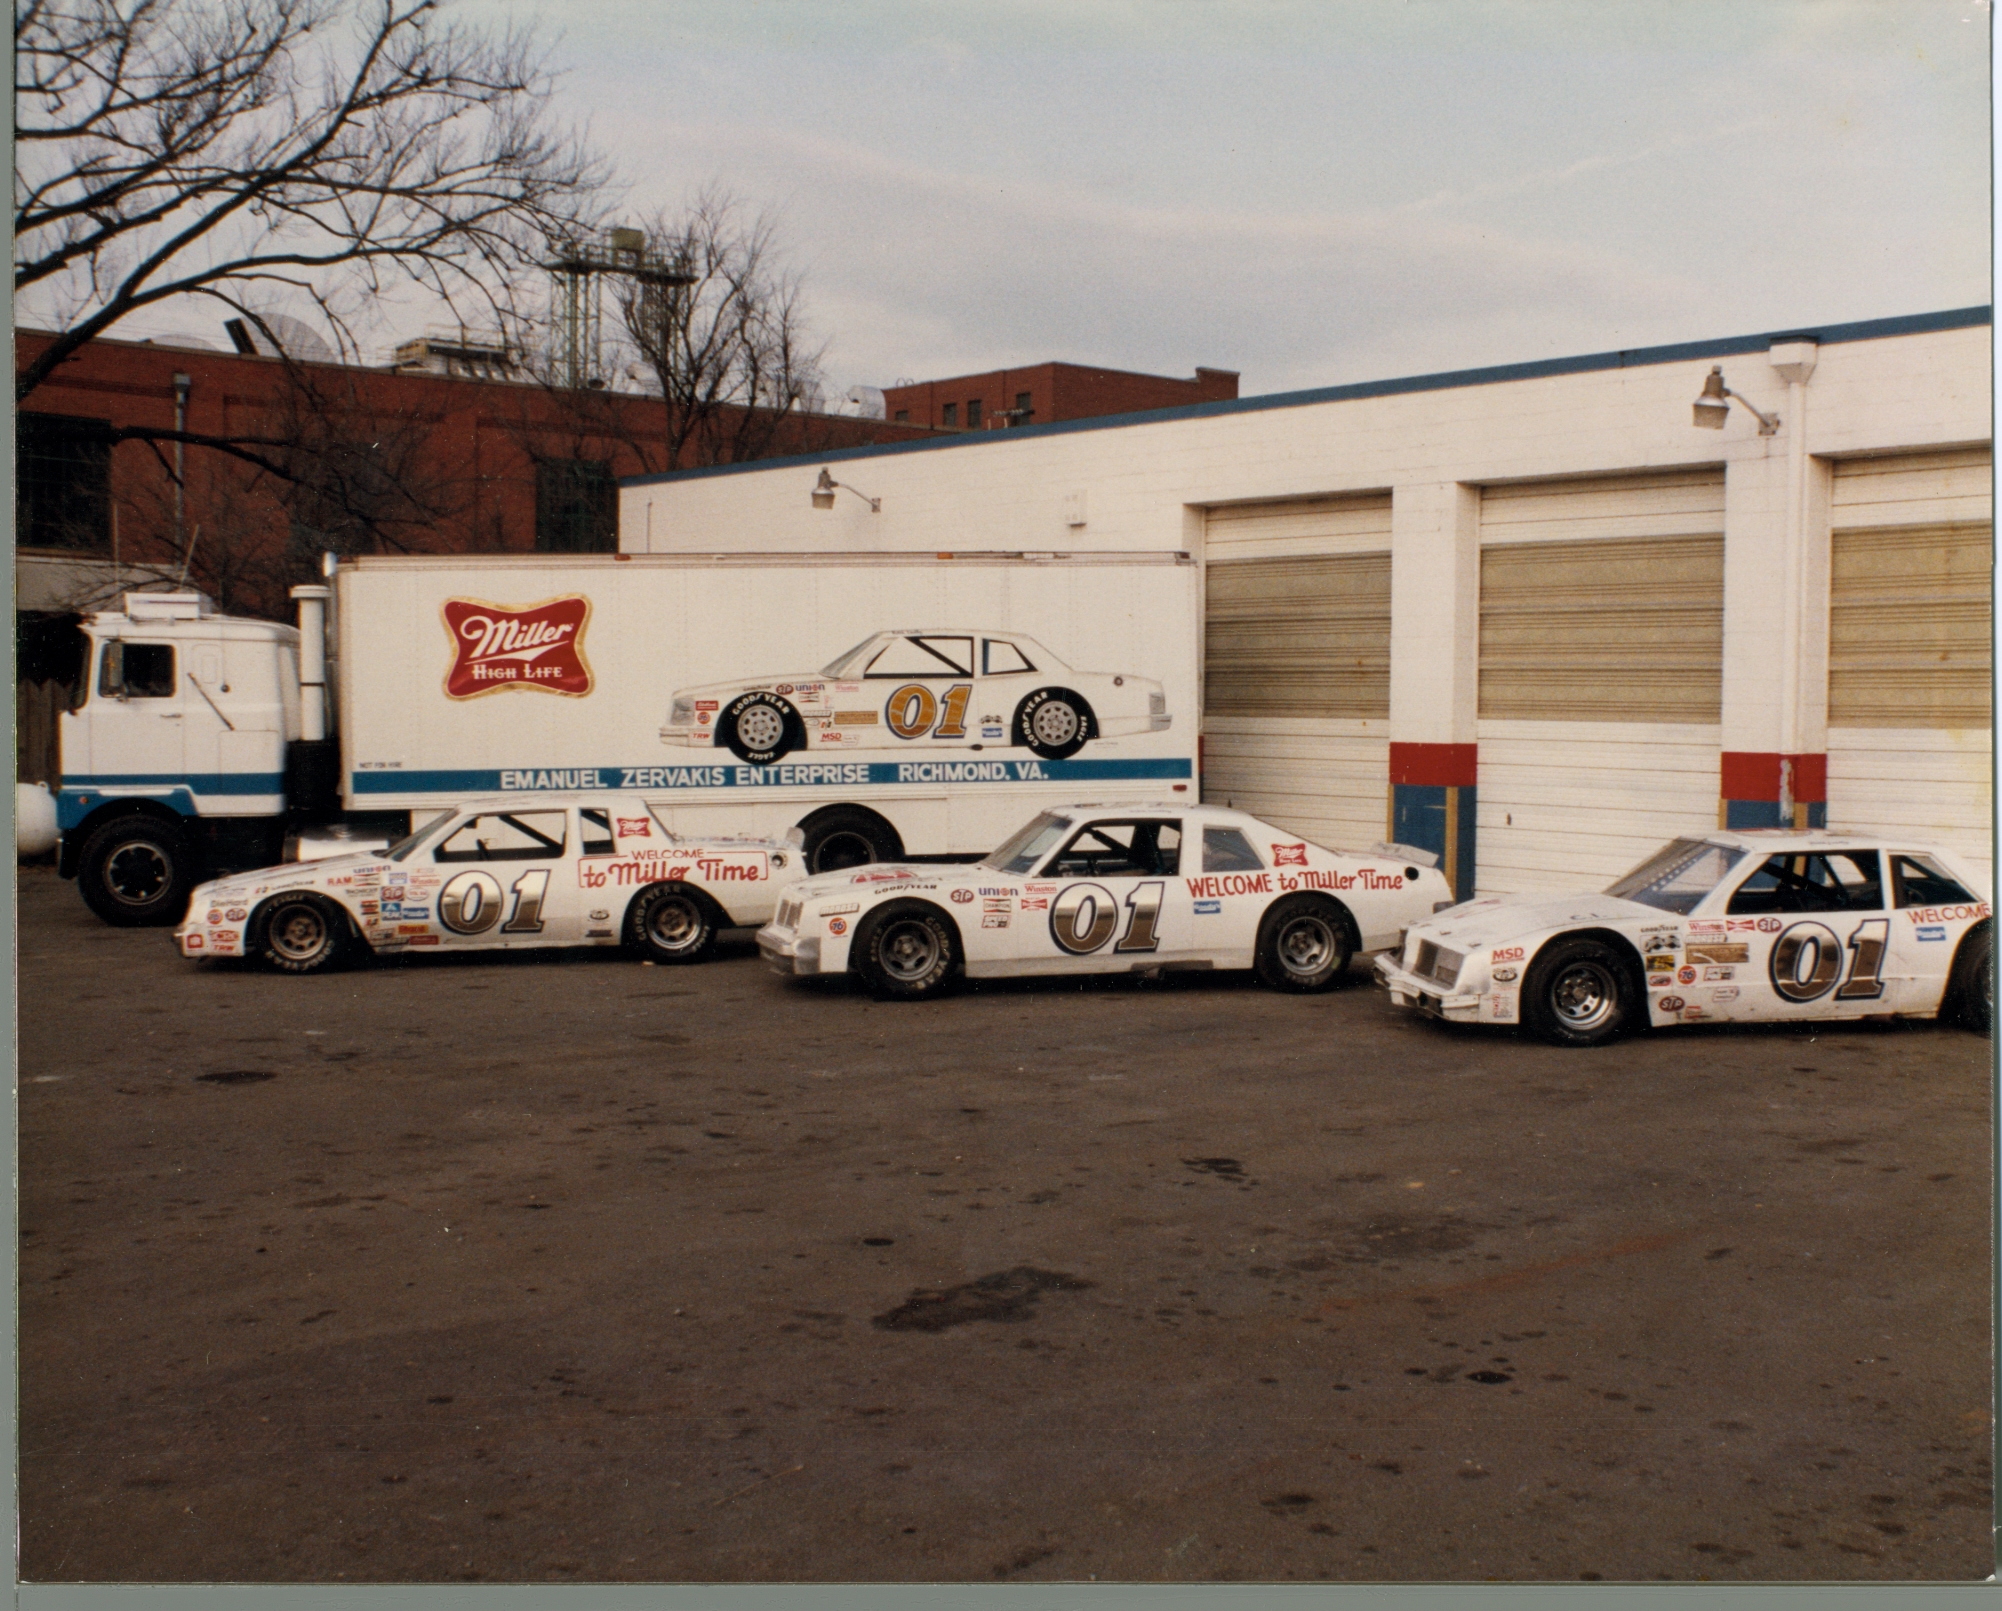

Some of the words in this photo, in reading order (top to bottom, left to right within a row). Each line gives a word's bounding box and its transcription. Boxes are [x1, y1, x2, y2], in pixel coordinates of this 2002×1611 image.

[460, 615, 573, 658] Miller
[472, 664, 517, 680] HIGH
[523, 663, 563, 679] LIFE
[886, 684, 973, 740] 01
[822, 733, 842, 741] MSD
[501, 769, 608, 789] EMANUEL
[621, 767, 726, 788] ZERVAKIS
[735, 764, 870, 785] ENTERPRISE
[1015, 762, 1049, 780] VA.
[631, 849, 705, 861] WELCOME
[327, 876, 352, 886] RAM
[583, 865, 607, 889] to
[608, 861, 691, 886] Miller
[697, 859, 759, 882] Time
[874, 884, 938, 895] GOODYEAR
[1186, 873, 1274, 899] WELCOME
[1277, 872, 1299, 891] to
[1298, 870, 1357, 890] Miller
[1357, 868, 1403, 890] Time
[383, 888, 403, 900] STP
[437, 869, 551, 935] 01
[952, 889, 973, 902] STP
[1049, 881, 1165, 956] 01
[1906, 903, 1992, 924] WELCOME
[1758, 918, 1781, 932] STP
[1492, 948, 1525, 961] MSD
[1768, 919, 1890, 1003] 01
[1660, 997, 1683, 1011] STP
